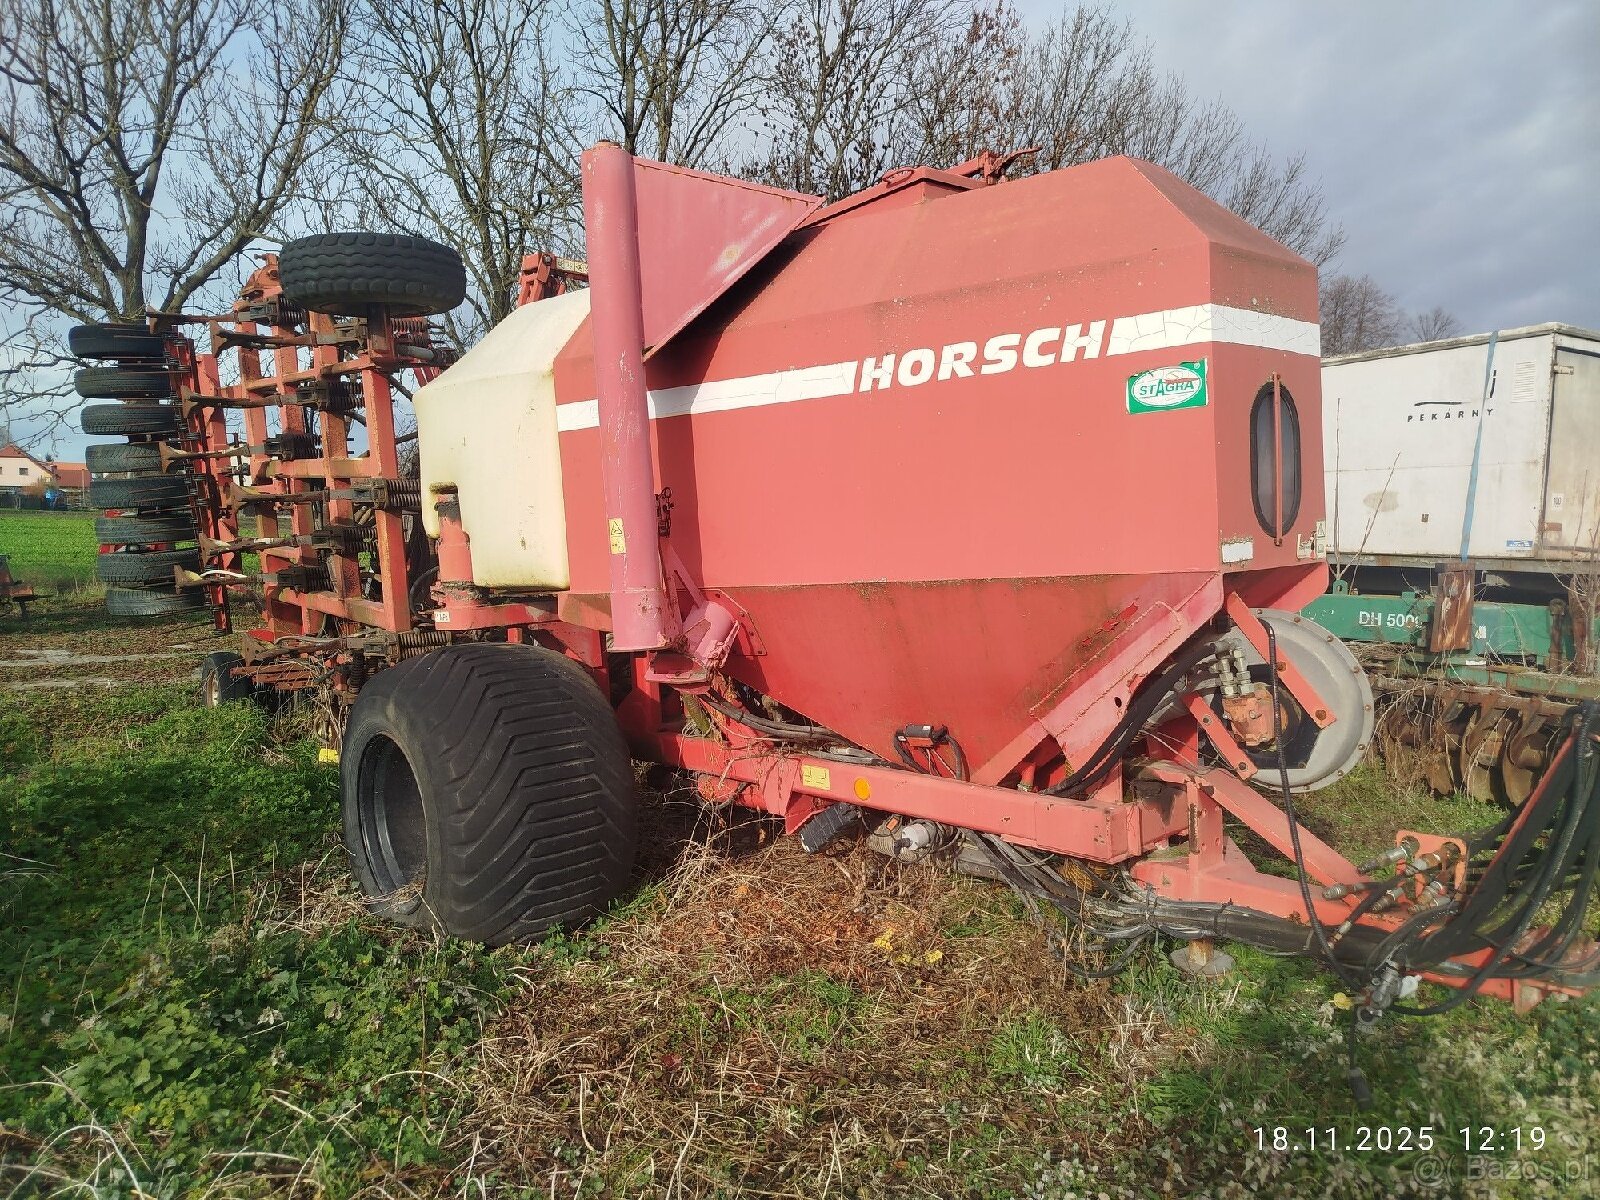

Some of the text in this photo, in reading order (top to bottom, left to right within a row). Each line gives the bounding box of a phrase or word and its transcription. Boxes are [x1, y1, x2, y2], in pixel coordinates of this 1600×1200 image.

[859, 320, 1106, 393] HORSCH
[1140, 379, 1194, 397] STAGRA
[1407, 408, 1493, 422] PEKÁRNY
[1359, 611, 1381, 626] DH
